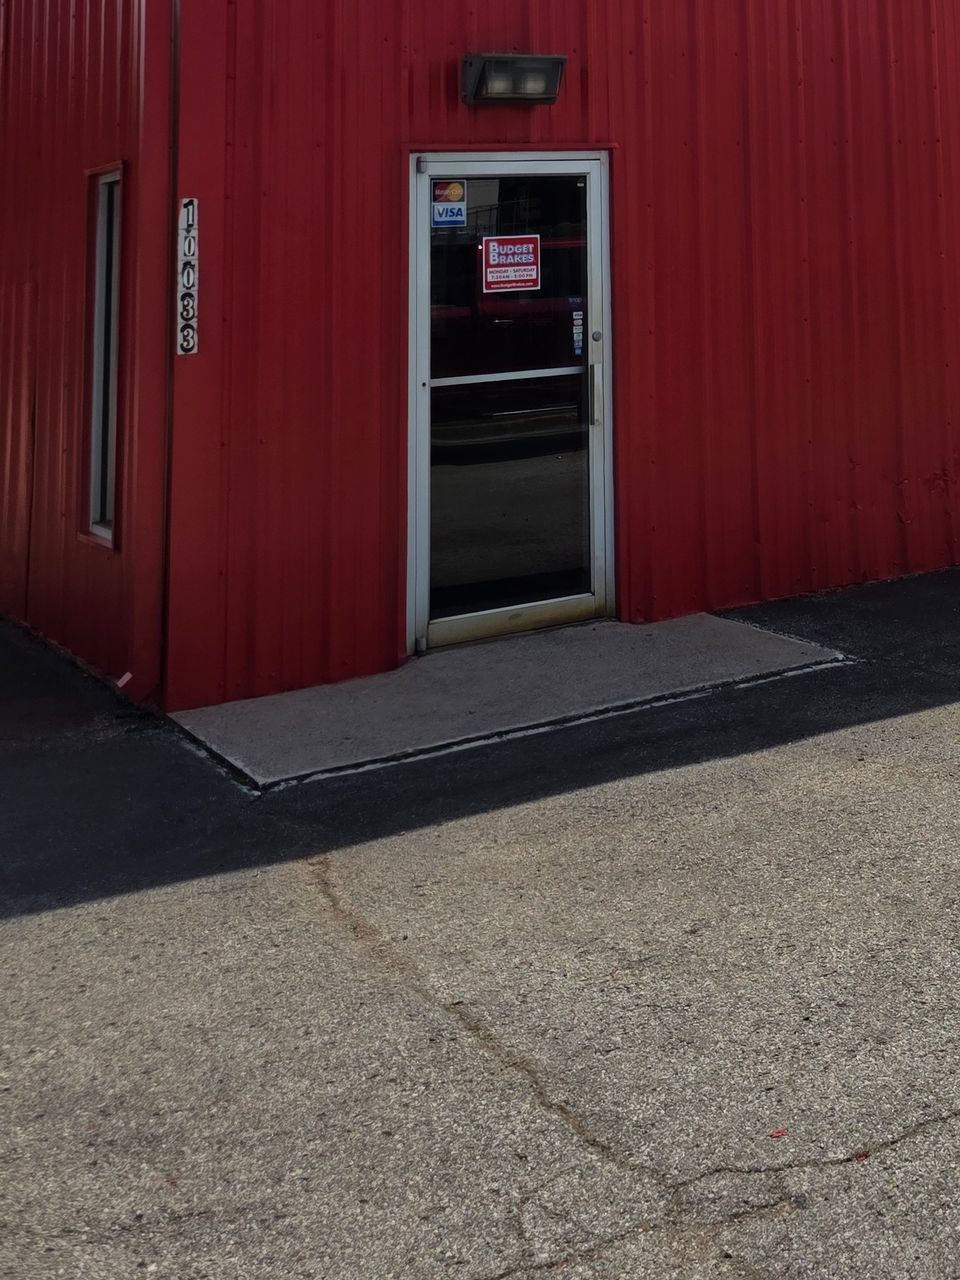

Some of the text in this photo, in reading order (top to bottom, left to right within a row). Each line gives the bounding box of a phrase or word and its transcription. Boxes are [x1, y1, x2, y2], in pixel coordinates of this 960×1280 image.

[436, 207, 463, 218] VISA
[489, 241, 535, 254] BUDGET
[489, 252, 535, 265] BRAKES
[178, 198, 197, 354] 10033
